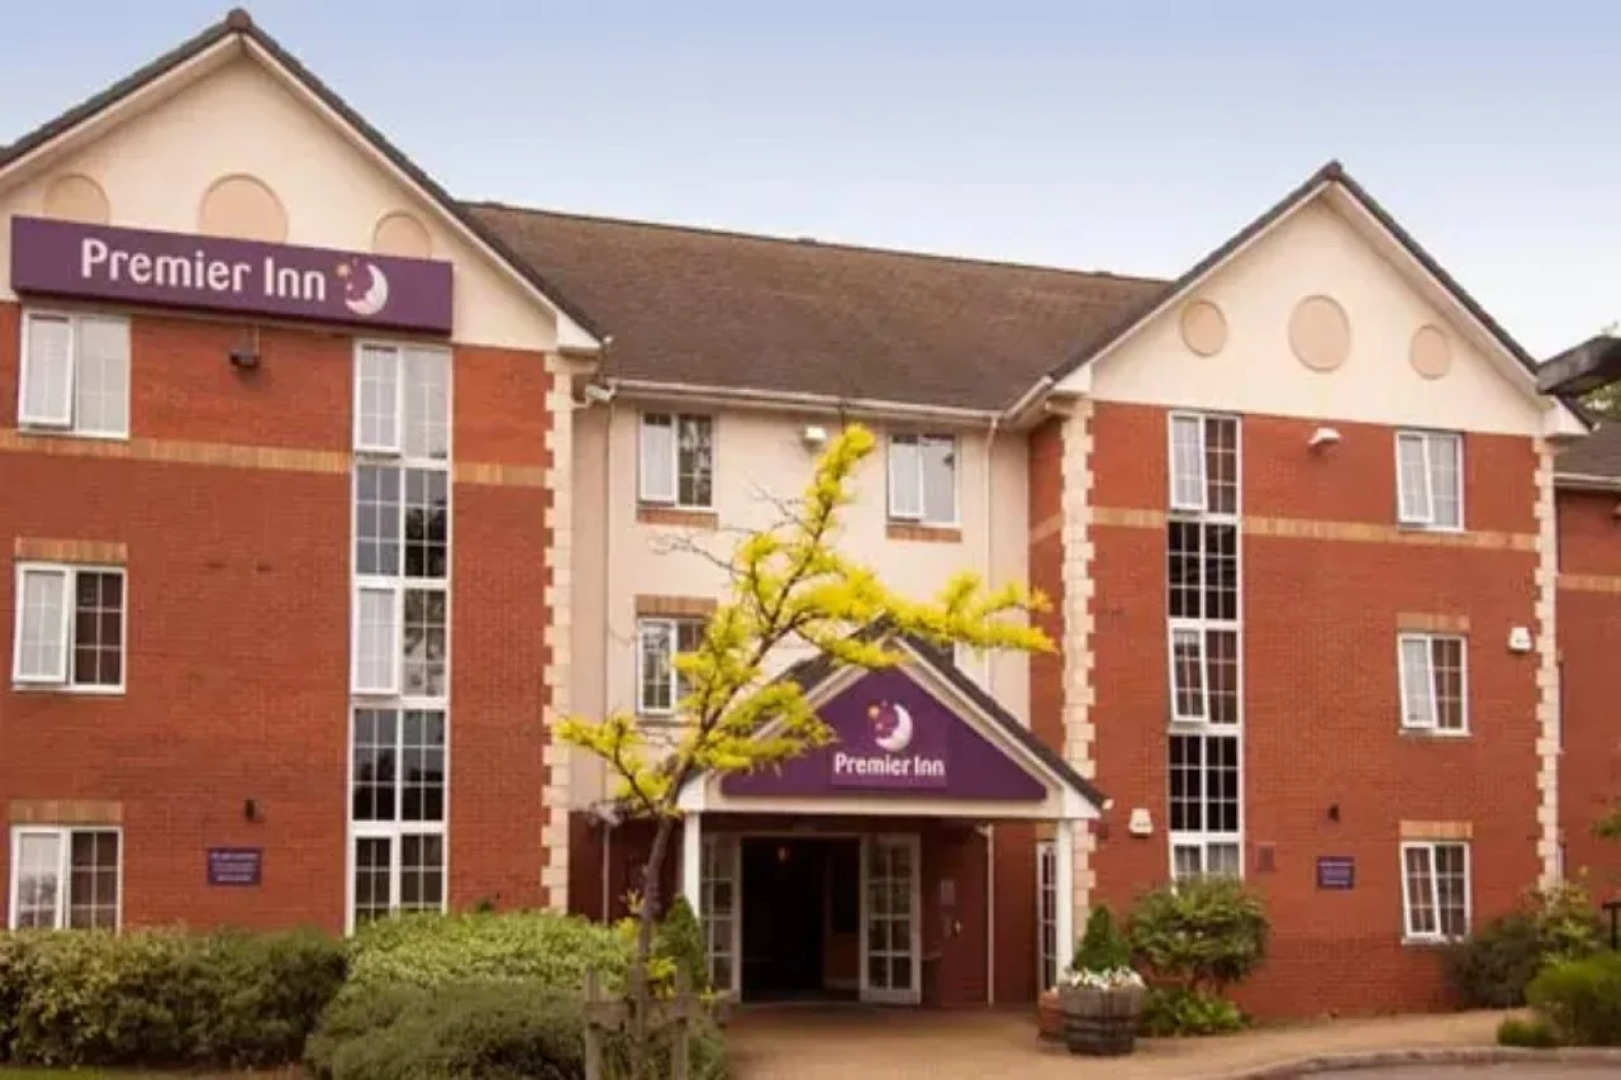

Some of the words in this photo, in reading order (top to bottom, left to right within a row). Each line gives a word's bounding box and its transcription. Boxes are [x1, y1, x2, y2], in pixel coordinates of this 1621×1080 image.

[81, 238, 251, 292] Premier
[264, 257, 326, 301] Inn
[833, 752, 911, 776] Premier
[914, 755, 946, 777] Inn
